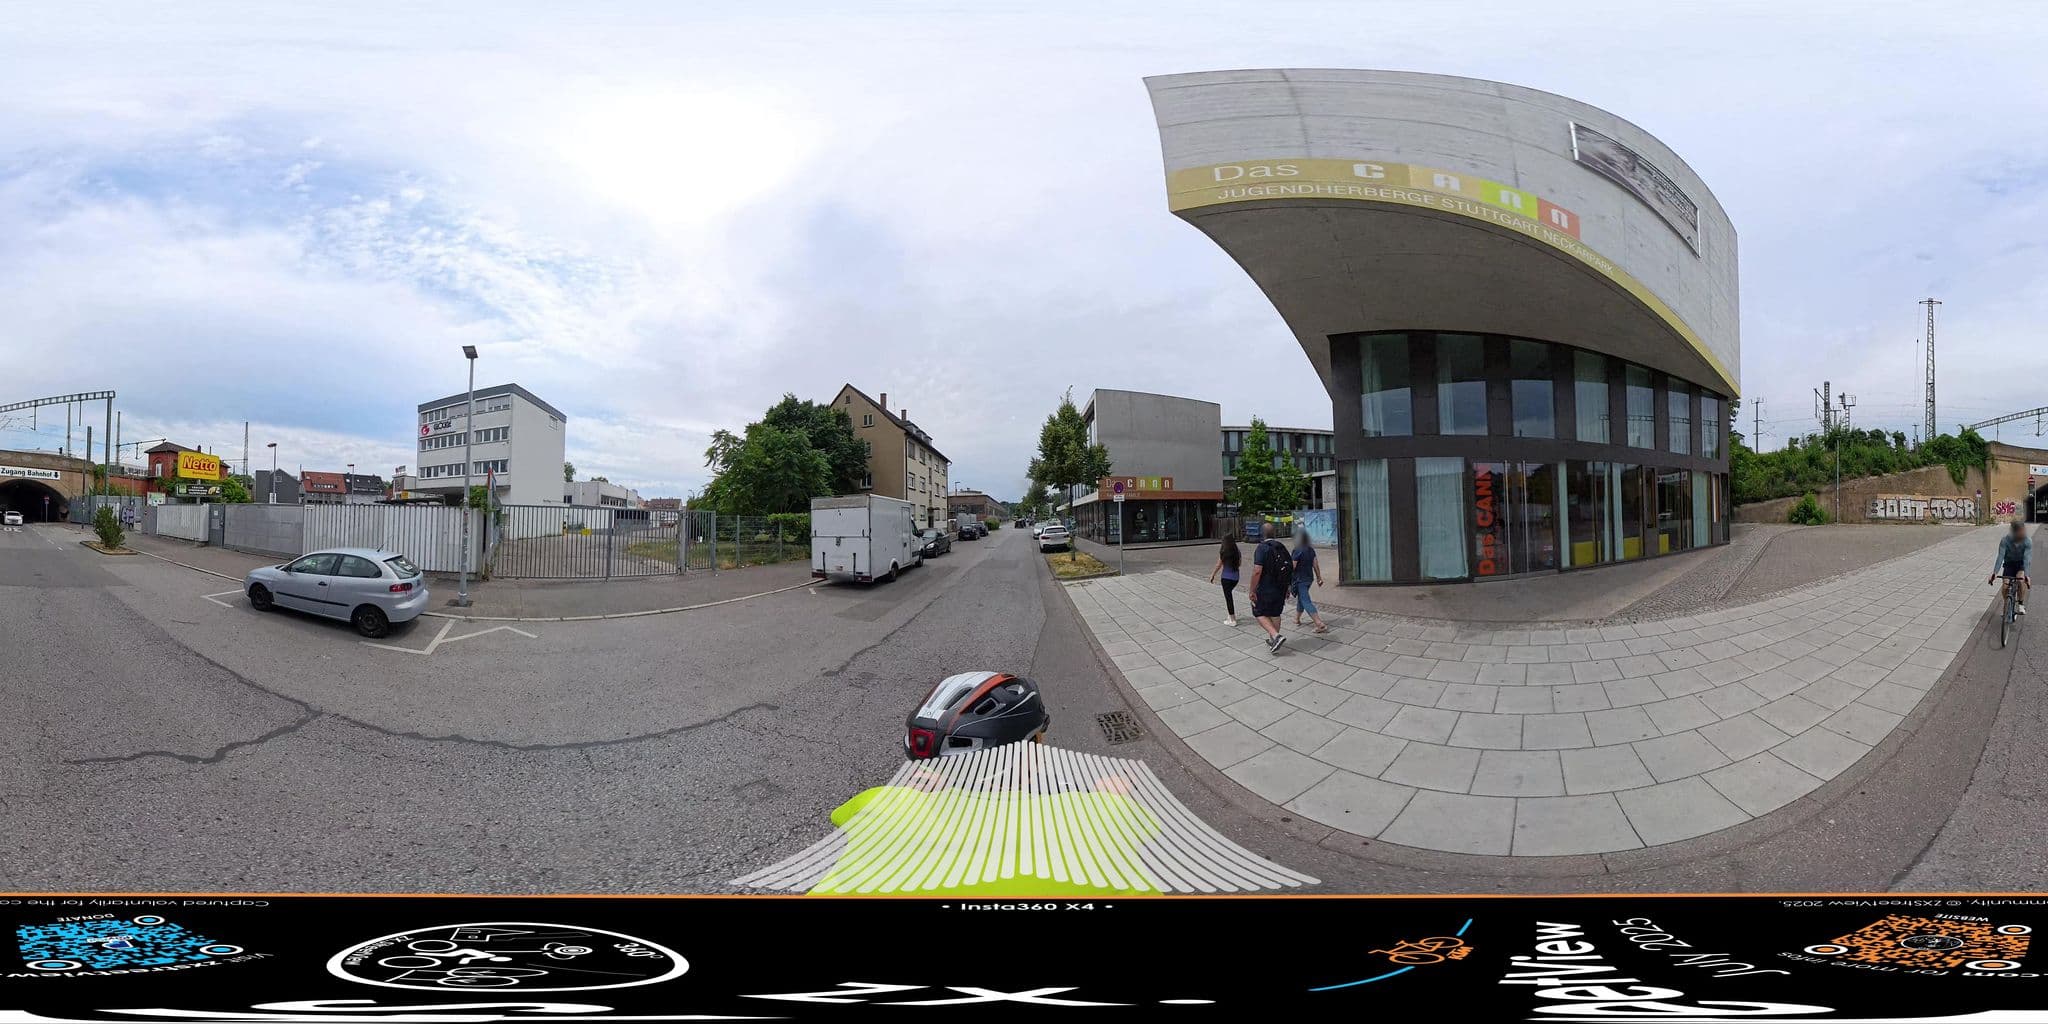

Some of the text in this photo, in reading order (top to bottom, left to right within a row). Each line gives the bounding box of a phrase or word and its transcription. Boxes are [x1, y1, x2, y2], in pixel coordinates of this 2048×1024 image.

[1214, 163, 1299, 182] Das
[1218, 184, 1614, 276] JUGENDHERBERGE STUTTGART NECKARPARK
[1, 467, 52, 478] Zugang Bahnhof
[183, 455, 217, 471] Netto
[1478, 533, 1496, 575] Das
